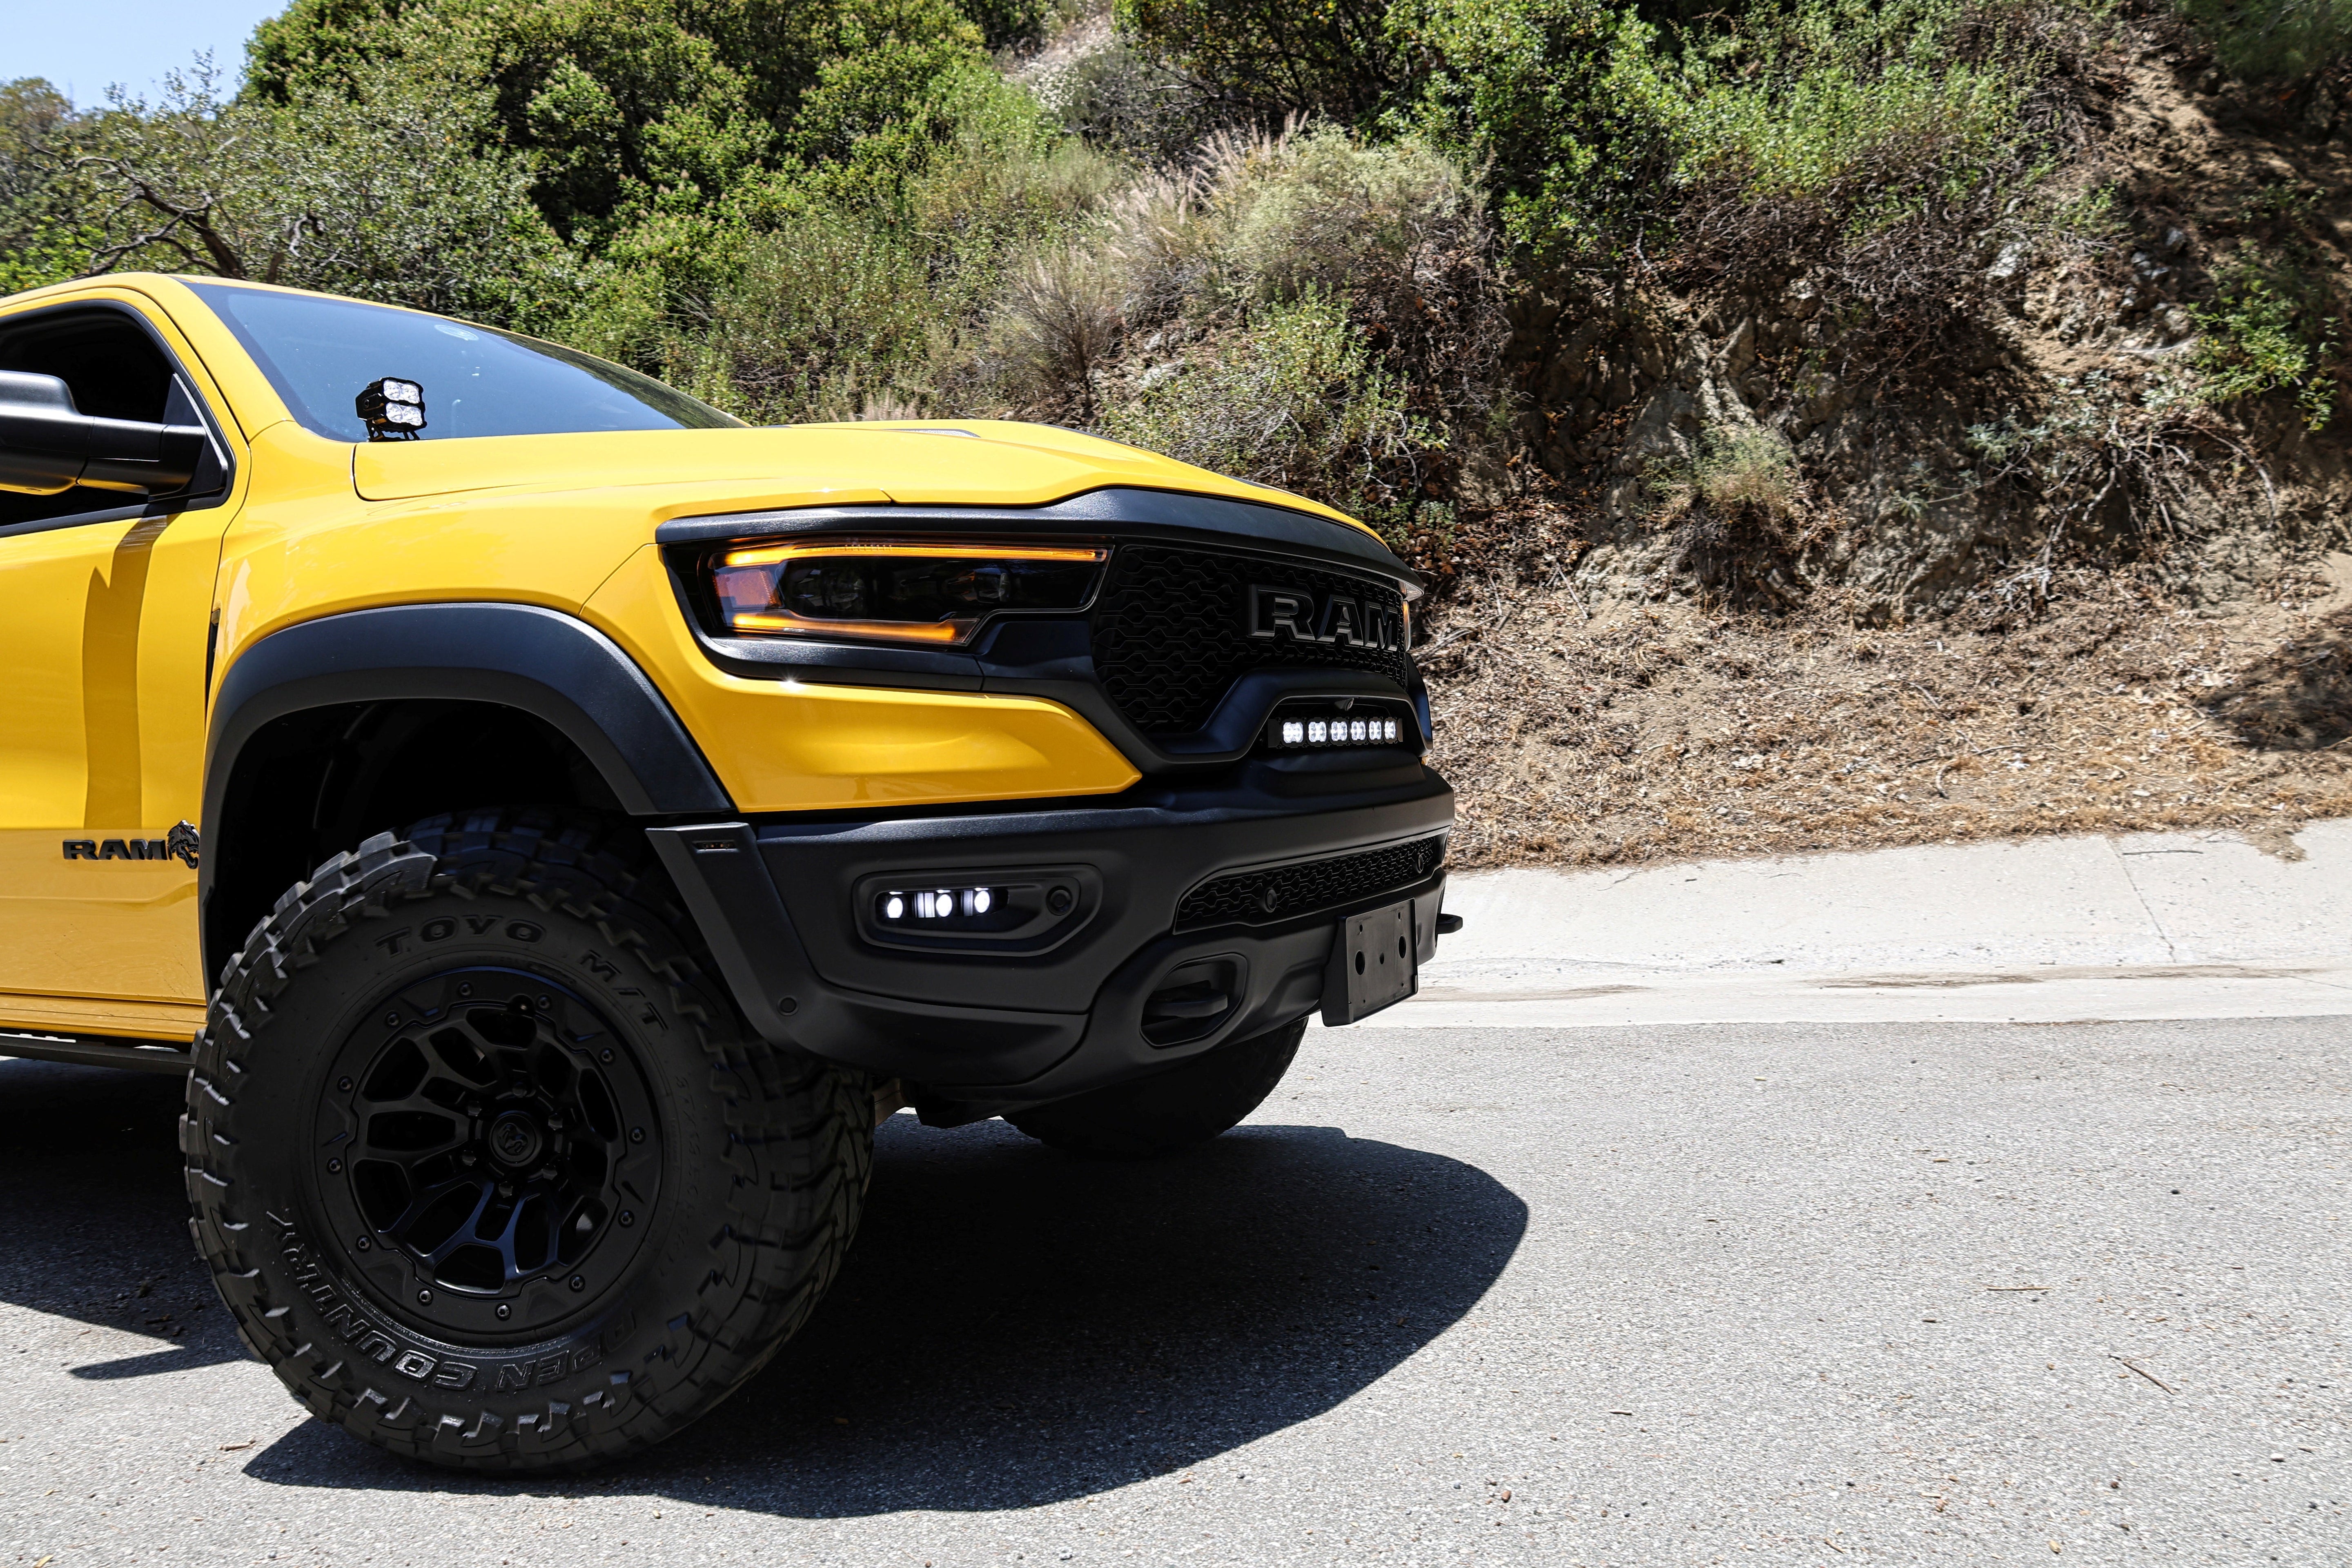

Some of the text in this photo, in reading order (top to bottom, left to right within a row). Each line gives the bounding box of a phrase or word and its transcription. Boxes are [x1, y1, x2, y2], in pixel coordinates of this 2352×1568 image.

[1248, 584, 1399, 651] RAM
[62, 839, 167, 860] RAM
[375, 914, 546, 957] TOYO
[579, 949, 669, 1031] M/T
[266, 1210, 479, 1391] COUNTRY
[496, 1307, 636, 1392] OPEN
